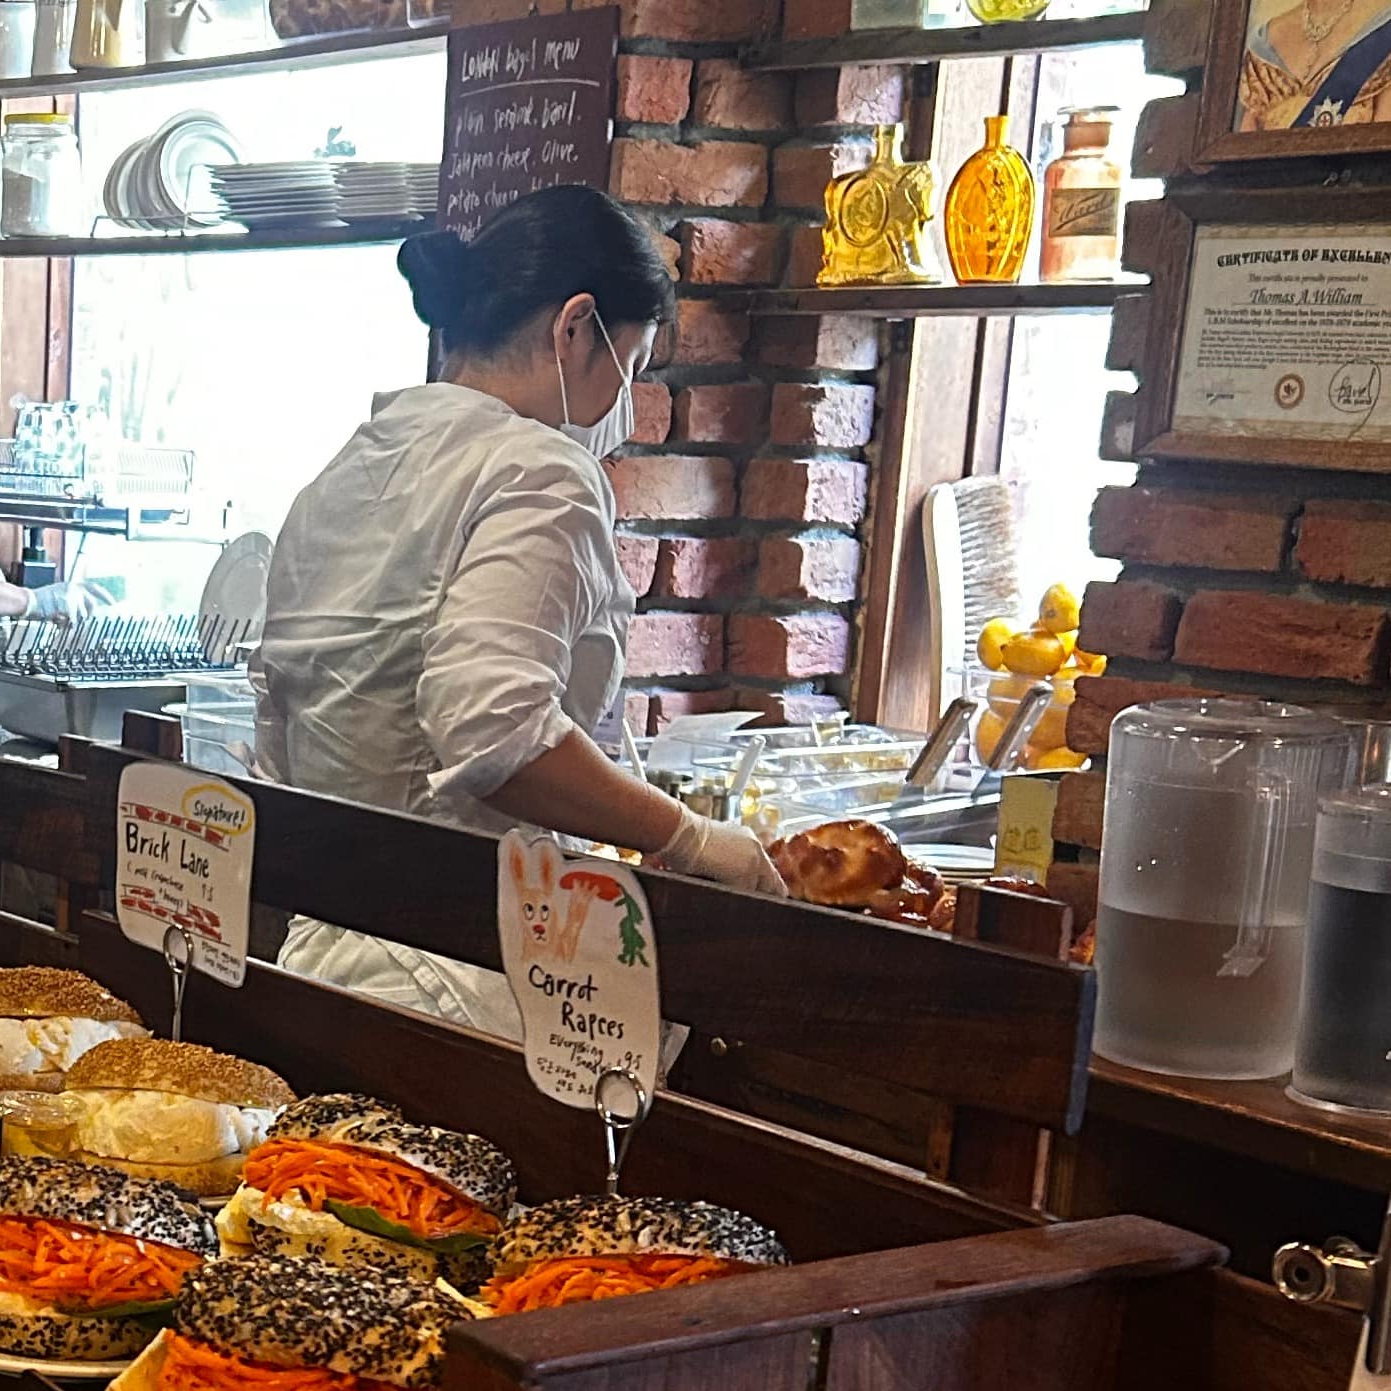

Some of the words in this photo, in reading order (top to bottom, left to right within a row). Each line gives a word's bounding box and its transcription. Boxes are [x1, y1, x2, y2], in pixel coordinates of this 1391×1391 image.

[1216, 248, 1299, 268] CERTIFICATE
[1301, 248, 1318, 263] OF
[1313, 286, 1364, 306] William
[125, 821, 171, 865] Brick
[180, 838, 211, 880] Lane
